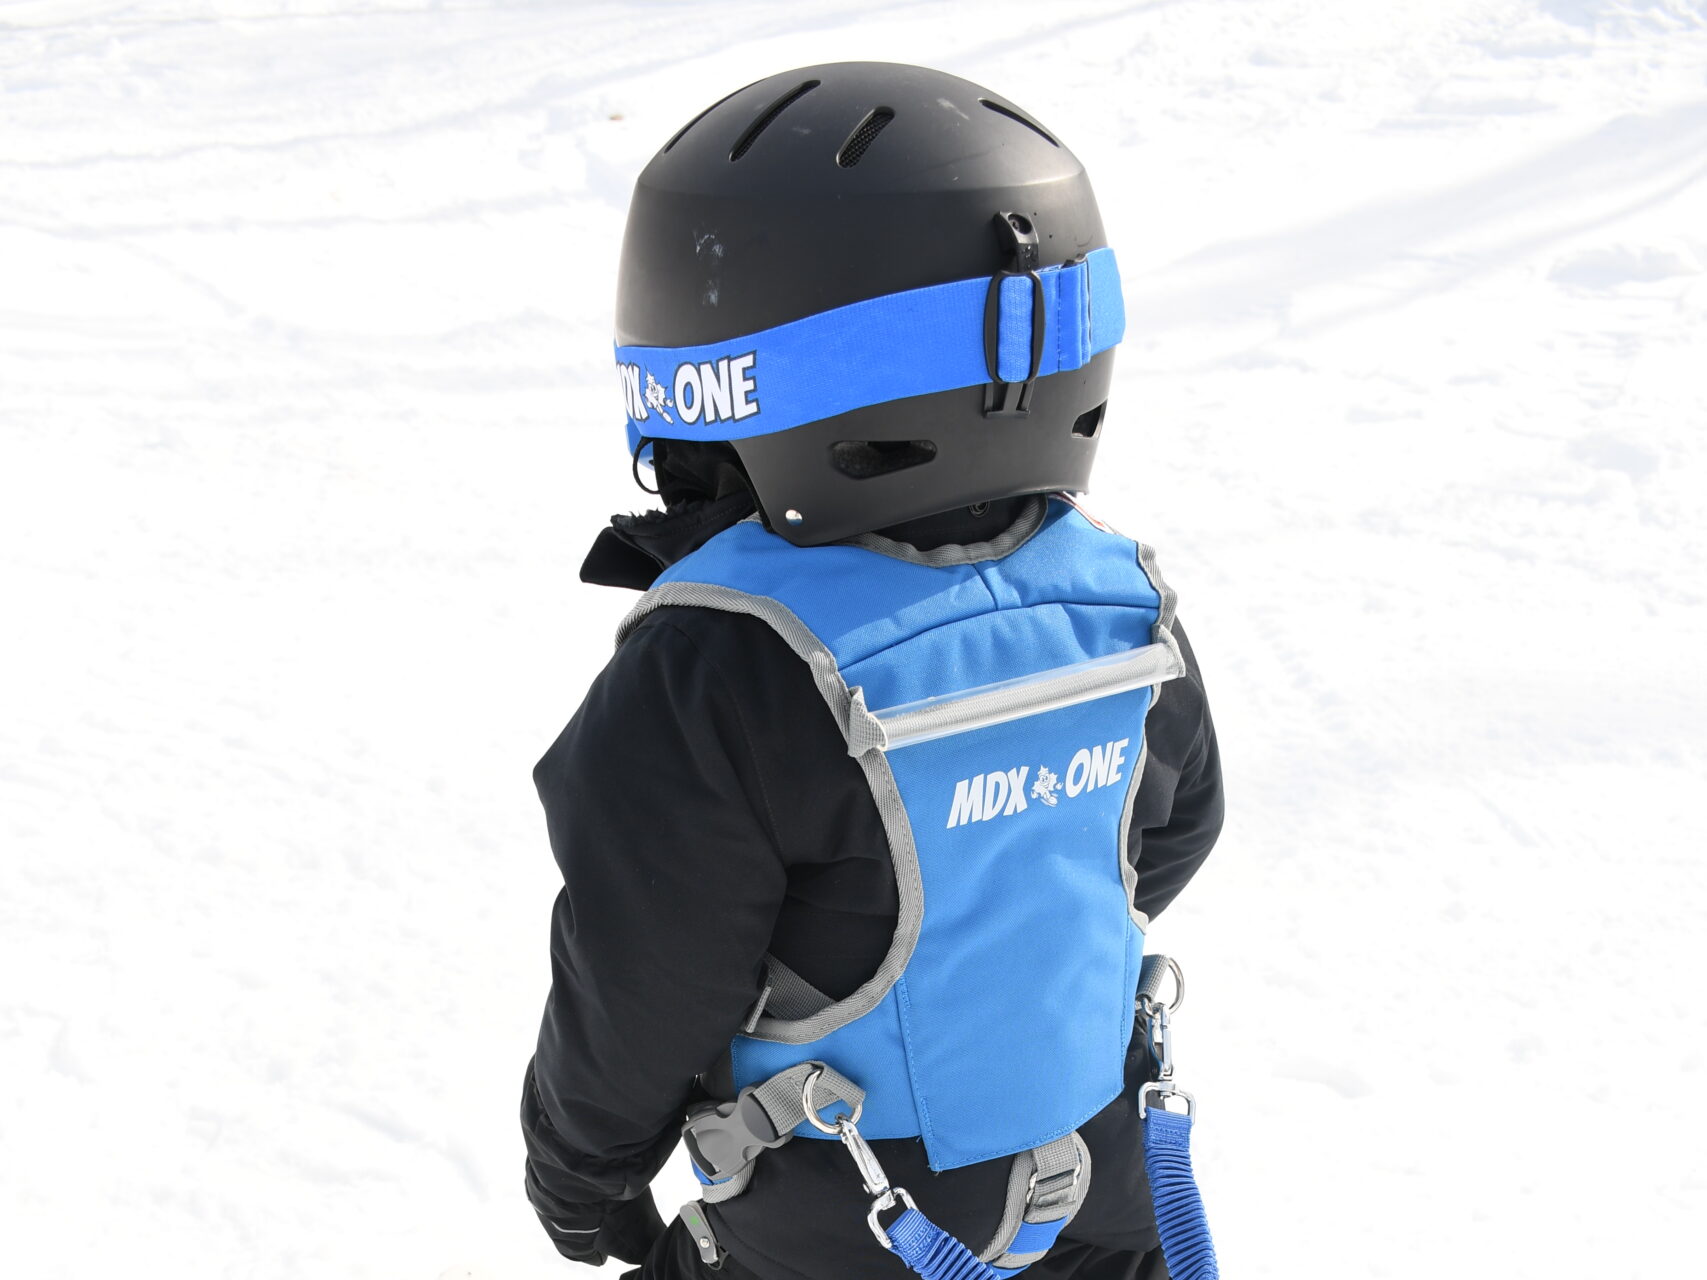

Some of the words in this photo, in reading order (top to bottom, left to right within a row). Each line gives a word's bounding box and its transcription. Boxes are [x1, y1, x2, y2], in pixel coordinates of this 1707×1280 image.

[616, 360, 649, 423] DX
[674, 350, 760, 426] ONE
[946, 766, 1030, 829] MDX
[1065, 738, 1130, 798] ONE
